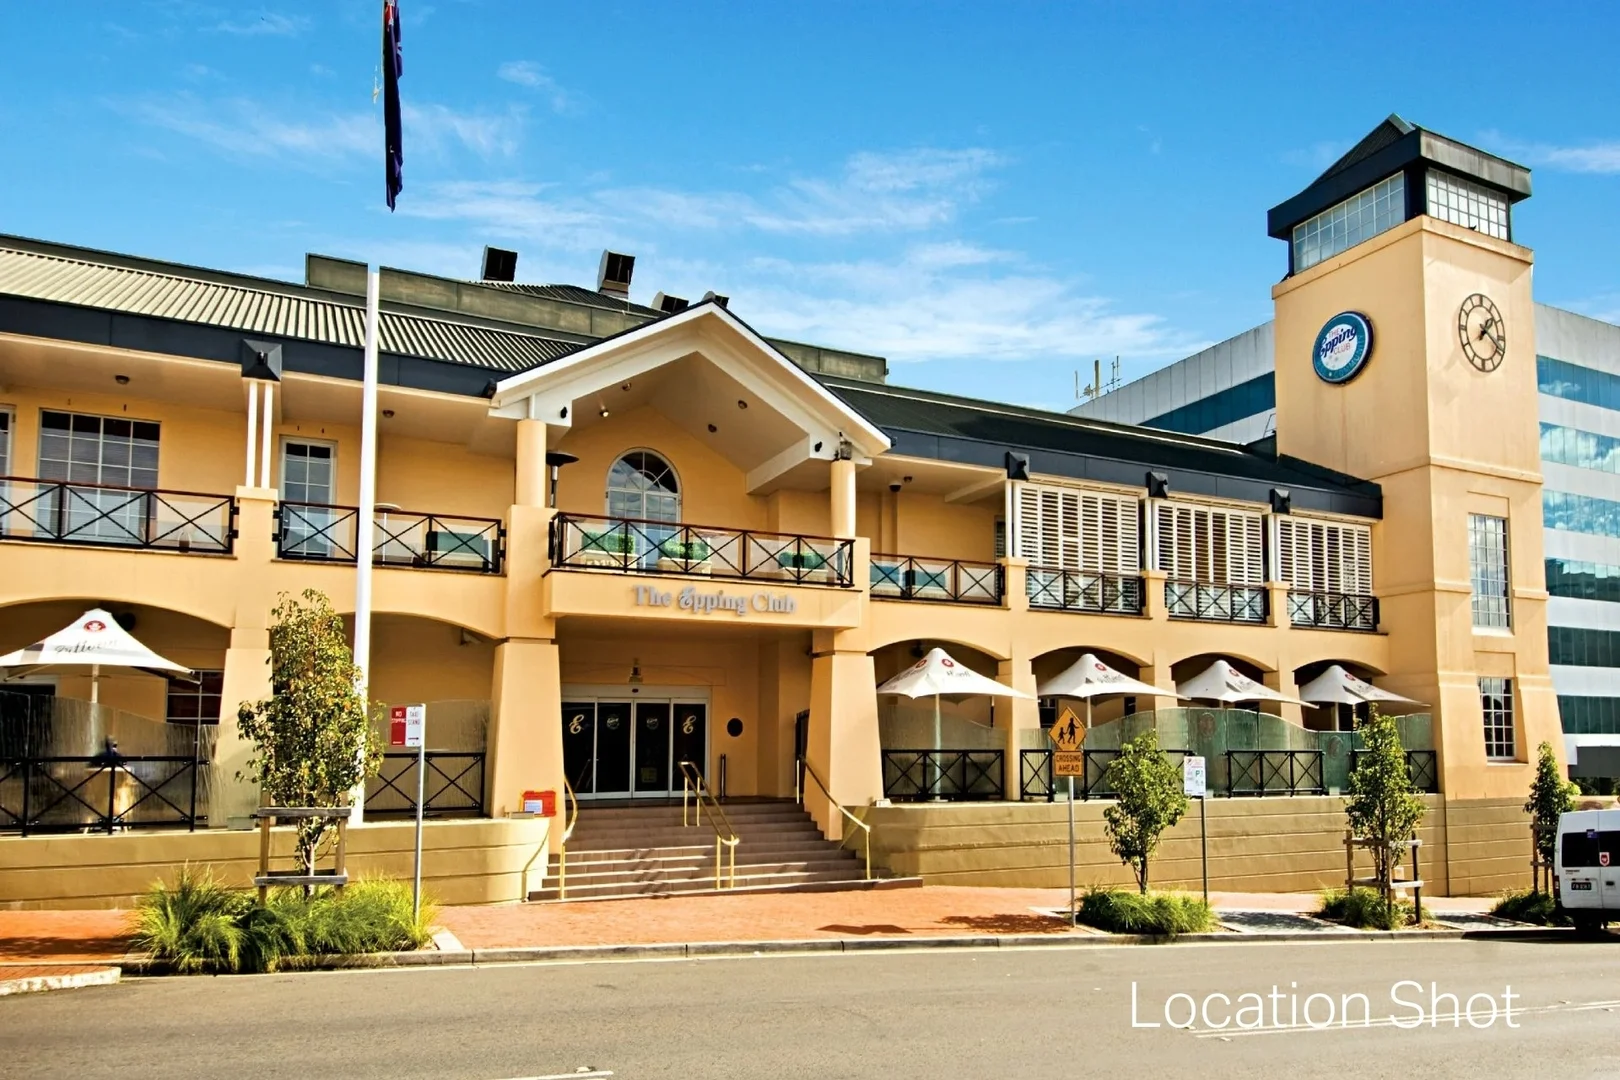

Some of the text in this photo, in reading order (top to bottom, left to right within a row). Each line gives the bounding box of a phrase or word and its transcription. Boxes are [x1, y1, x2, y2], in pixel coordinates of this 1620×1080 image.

[633, 585, 797, 616] The Epping Club
[1056, 754, 1081, 762] CROSSING
[1058, 764, 1080, 773] AHEAD
